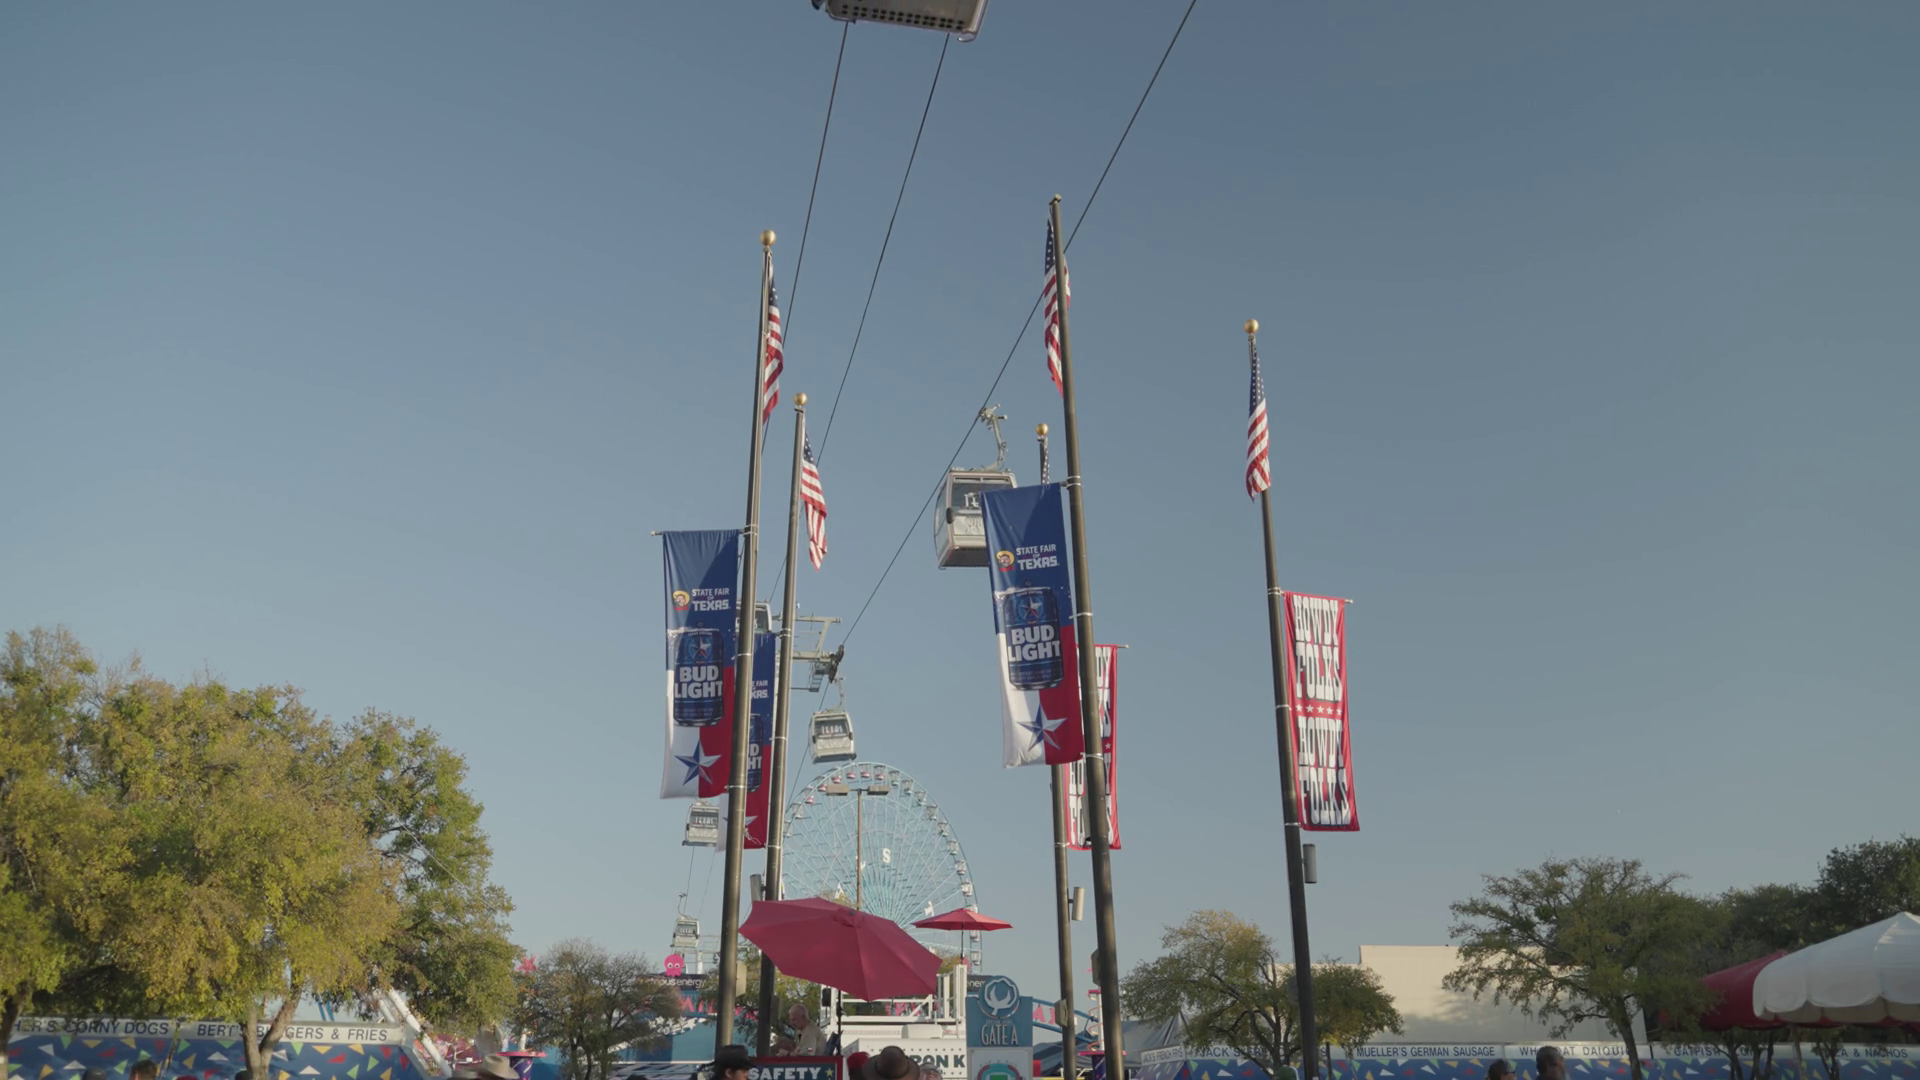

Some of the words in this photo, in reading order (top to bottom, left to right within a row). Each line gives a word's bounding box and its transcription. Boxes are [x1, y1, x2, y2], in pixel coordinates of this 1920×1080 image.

[1016, 546, 1039, 556] STATE
[1040, 543, 1057, 553] FAIR
[1017, 555, 1058, 571] TEXAS
[692, 589, 713, 597] STATE
[692, 600, 729, 612] TEXAS
[1293, 595, 1339, 647] HOWDY
[1011, 625, 1055, 645] BUD
[1008, 640, 1061, 662] LIGHT
[680, 665, 719, 682] BUD
[1296, 641, 1343, 702] FOLKS
[675, 681, 723, 699] LIGHT
[752, 690, 768, 699] XAS
[1298, 716, 1343, 769] HOWDY
[1300, 766, 1351, 826] FOLKS
[64, 1021, 119, 1033] CORNY
[124, 1022, 169, 1034] DOGS
[257, 1026, 324, 1039] BGERS
[331, 1029, 340, 1039] &
[347, 1029, 388, 1041] FRIES
[981, 1024, 1008, 1045] GATE
[1011, 1024, 1019, 1045] A
[1357, 1047, 1407, 1057] MUELLER'S
[1410, 1047, 1449, 1057] GERMAN
[1453, 1046, 1494, 1056] SAUSAGE
[1583, 1047, 1631, 1056] DAIQUI
[1865, 1048, 1908, 1058] NACHOS
[748, 1067, 821, 1080] SAFETY
